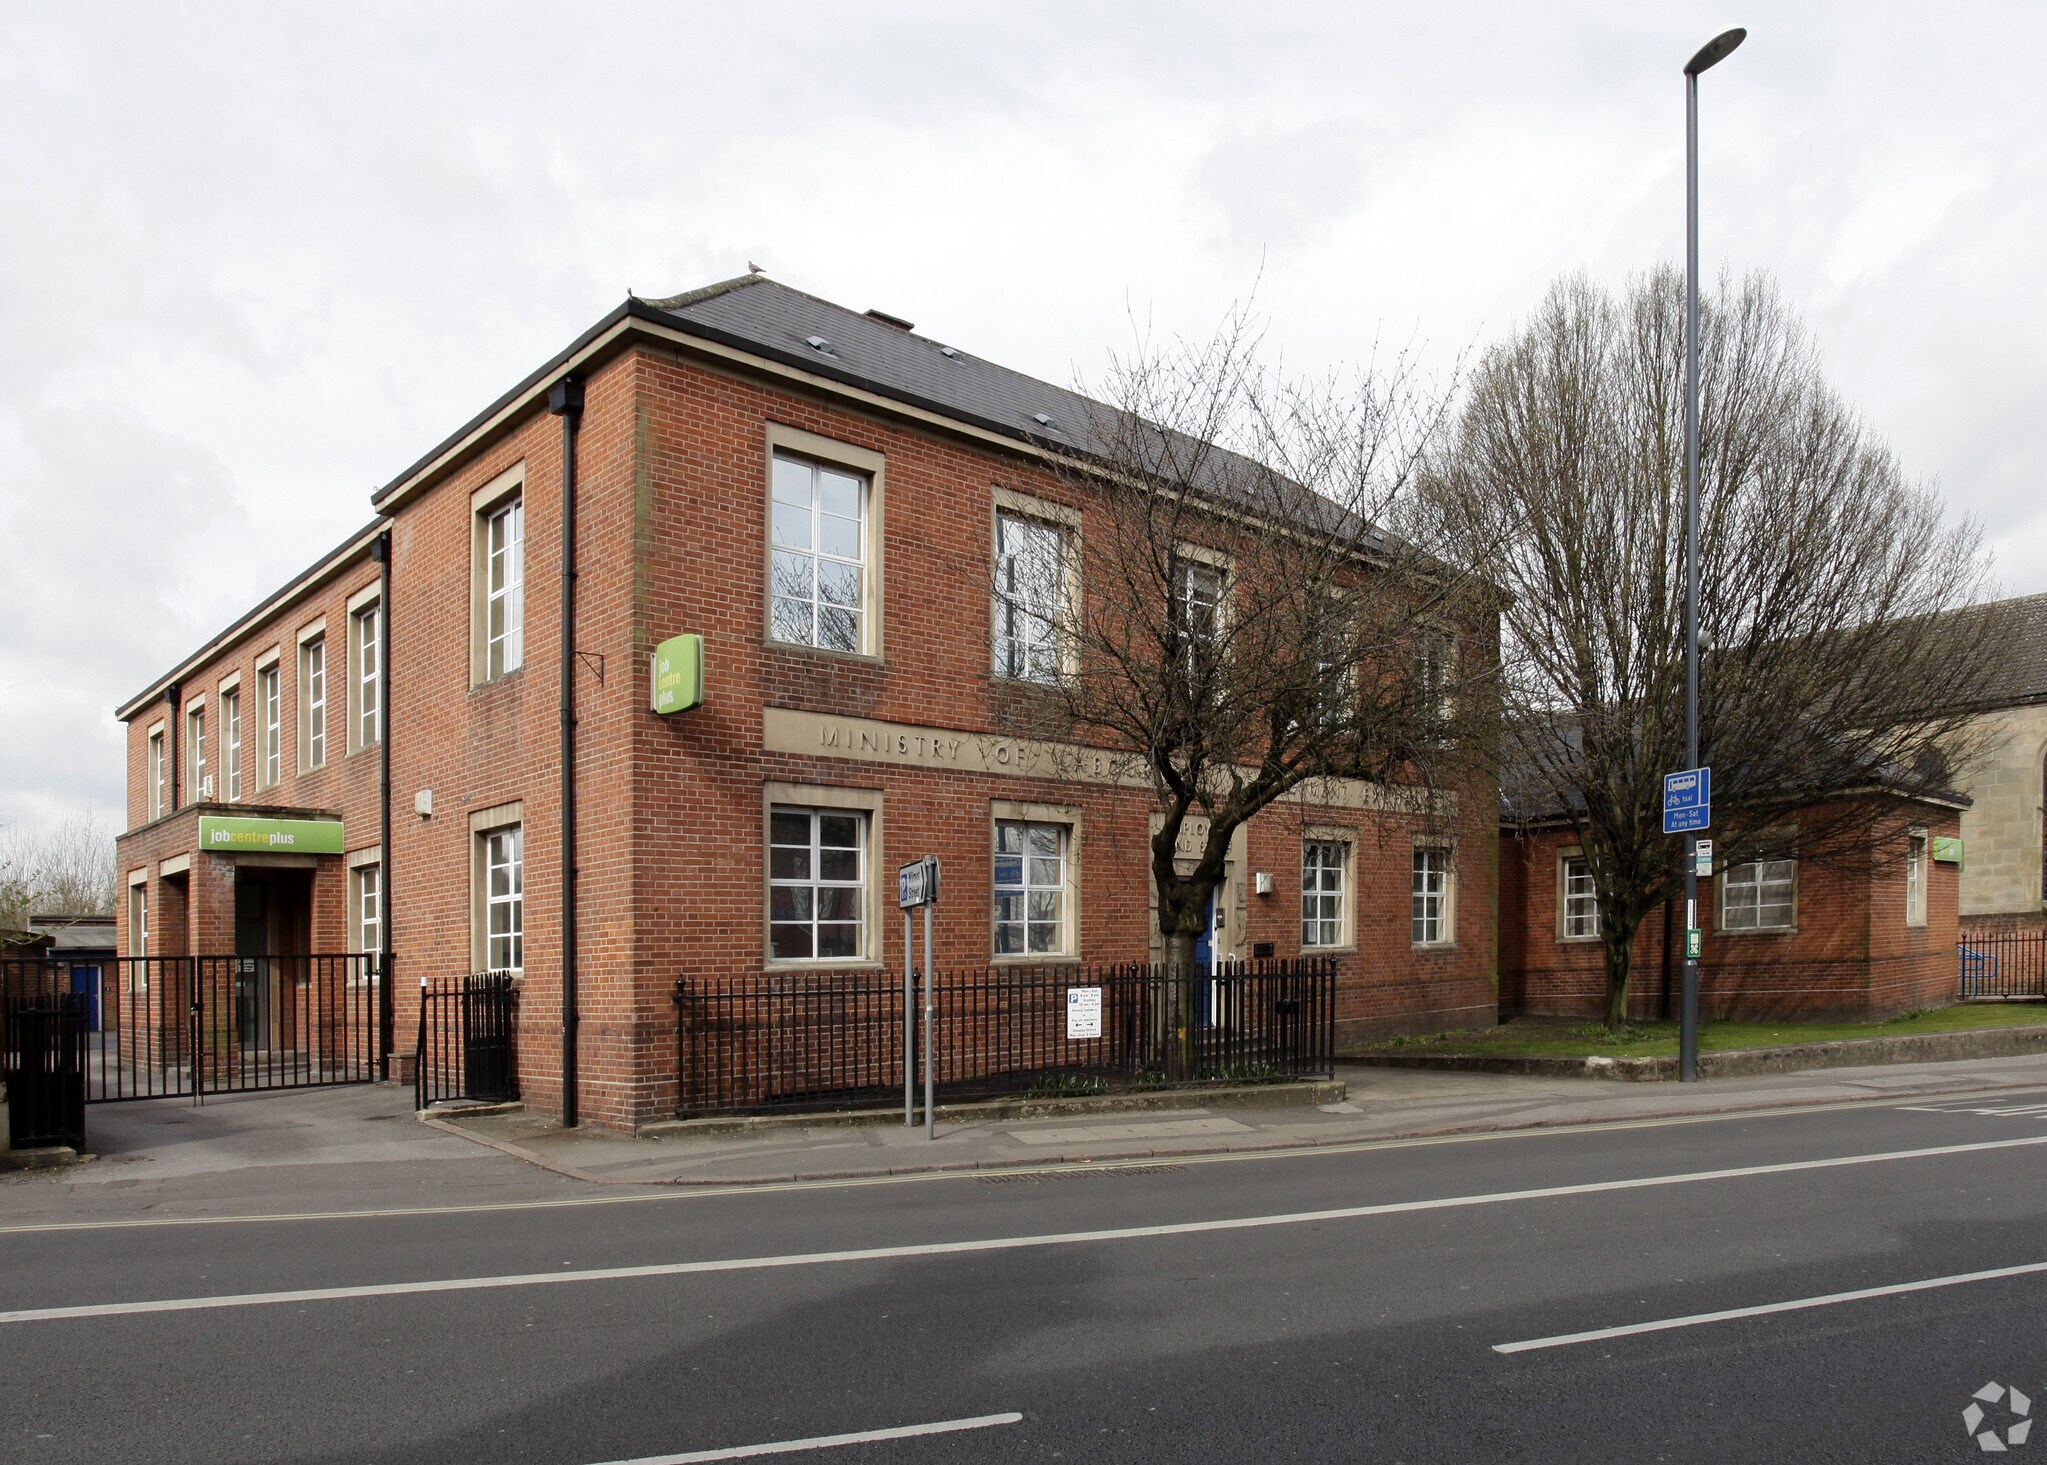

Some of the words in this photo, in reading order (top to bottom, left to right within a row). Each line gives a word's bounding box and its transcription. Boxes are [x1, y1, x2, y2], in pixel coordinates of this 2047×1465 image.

[658, 657, 670, 678] job
[658, 671, 681, 689] centre
[658, 689, 674, 709] plus
[820, 724, 959, 760] MINISTRY
[996, 746, 1030, 766] OF
[1682, 794, 1693, 802] taxi
[1673, 812, 1686, 820] Mon
[1689, 809, 1699, 818] Sat
[1679, 820, 1689, 828] any
[1689, 818, 1702, 826] time
[210, 828, 295, 846] jobcentreplus
